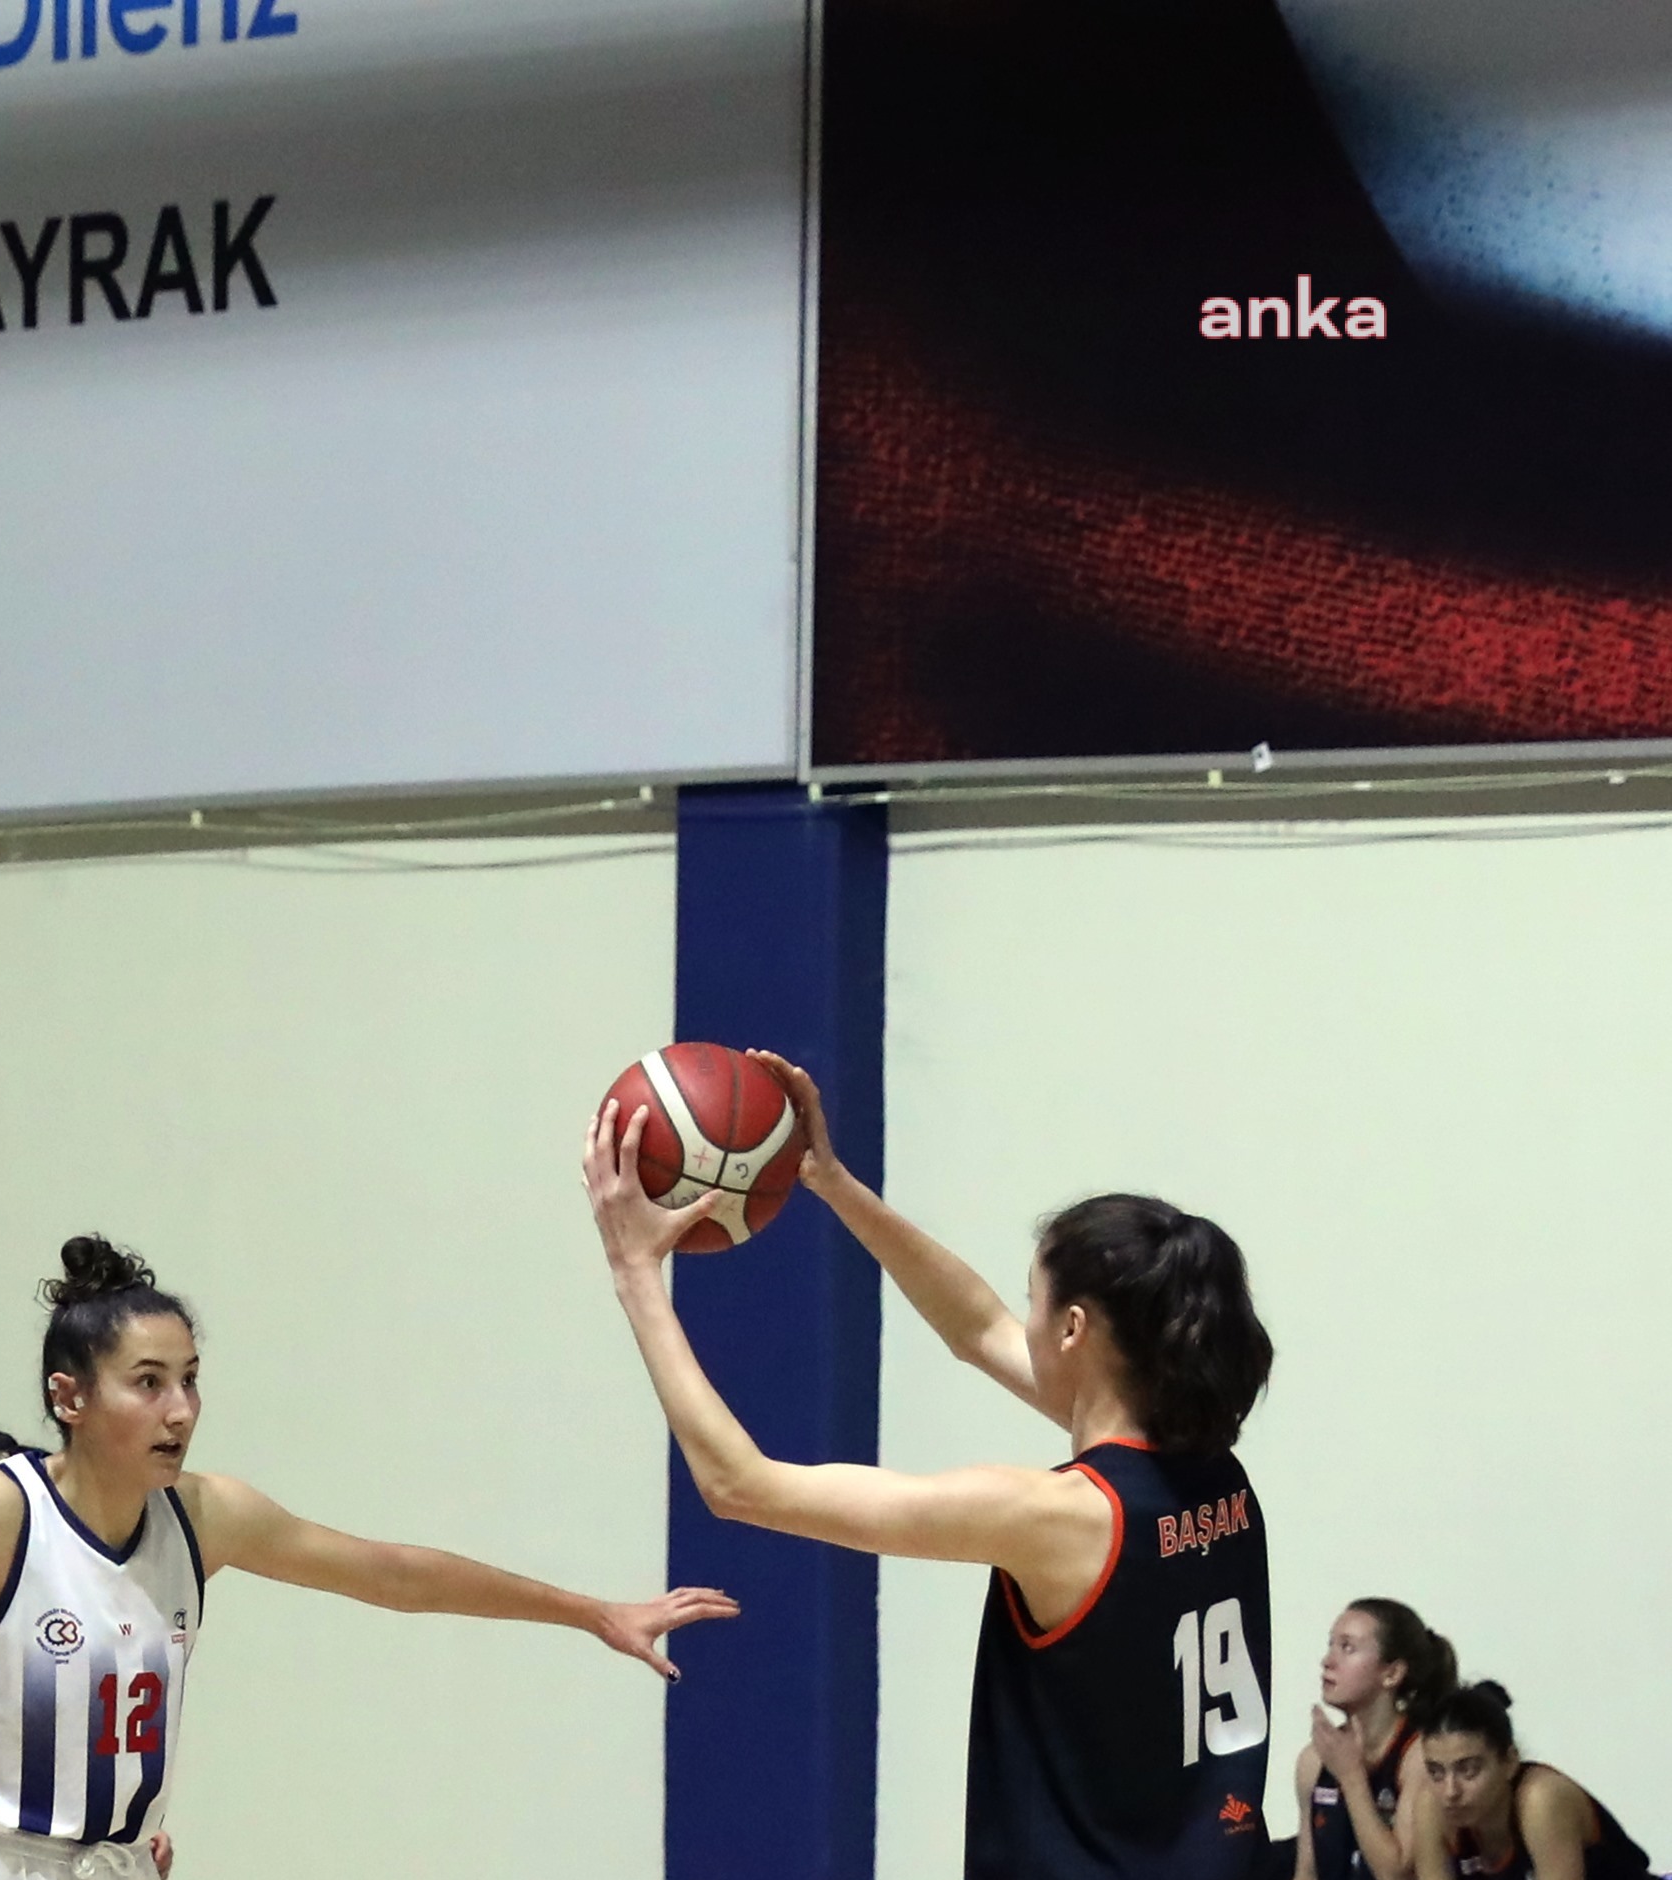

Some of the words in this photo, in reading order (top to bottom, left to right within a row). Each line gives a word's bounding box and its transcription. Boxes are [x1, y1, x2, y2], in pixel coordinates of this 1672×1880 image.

[1157, 1488, 1250, 1558] BAŞAK
[95, 1671, 163, 1755] 12
[1172, 1597, 1269, 1768] 19
